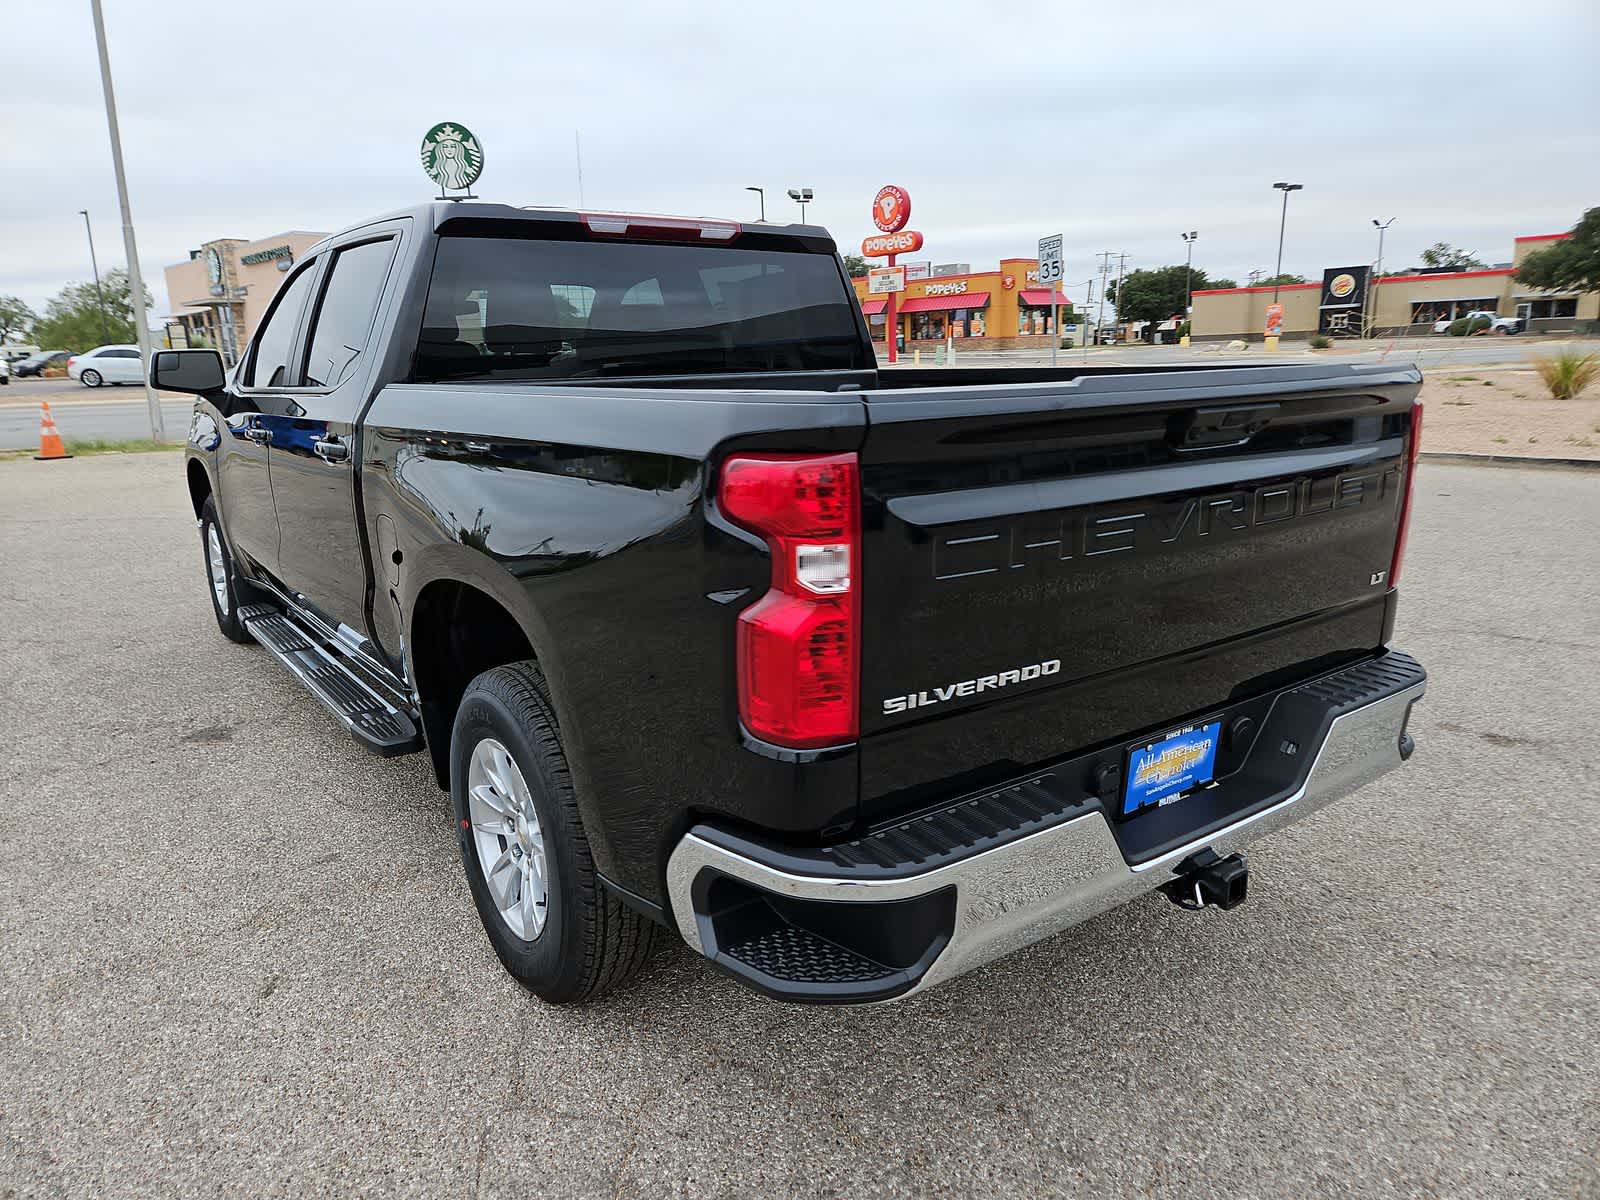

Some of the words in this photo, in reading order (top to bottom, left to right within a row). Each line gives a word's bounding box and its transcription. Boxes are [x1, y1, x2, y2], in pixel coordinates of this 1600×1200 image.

[1040, 239, 1061, 251] SPEED
[1041, 249, 1060, 261] LIMIT
[1041, 260, 1060, 279] 35
[931, 466, 1403, 580] CHEVROLET
[1370, 570, 1387, 585] LT
[882, 659, 1062, 715] SILVERADO
[1136, 753, 1155, 773] All
[1157, 739, 1211, 761] American
